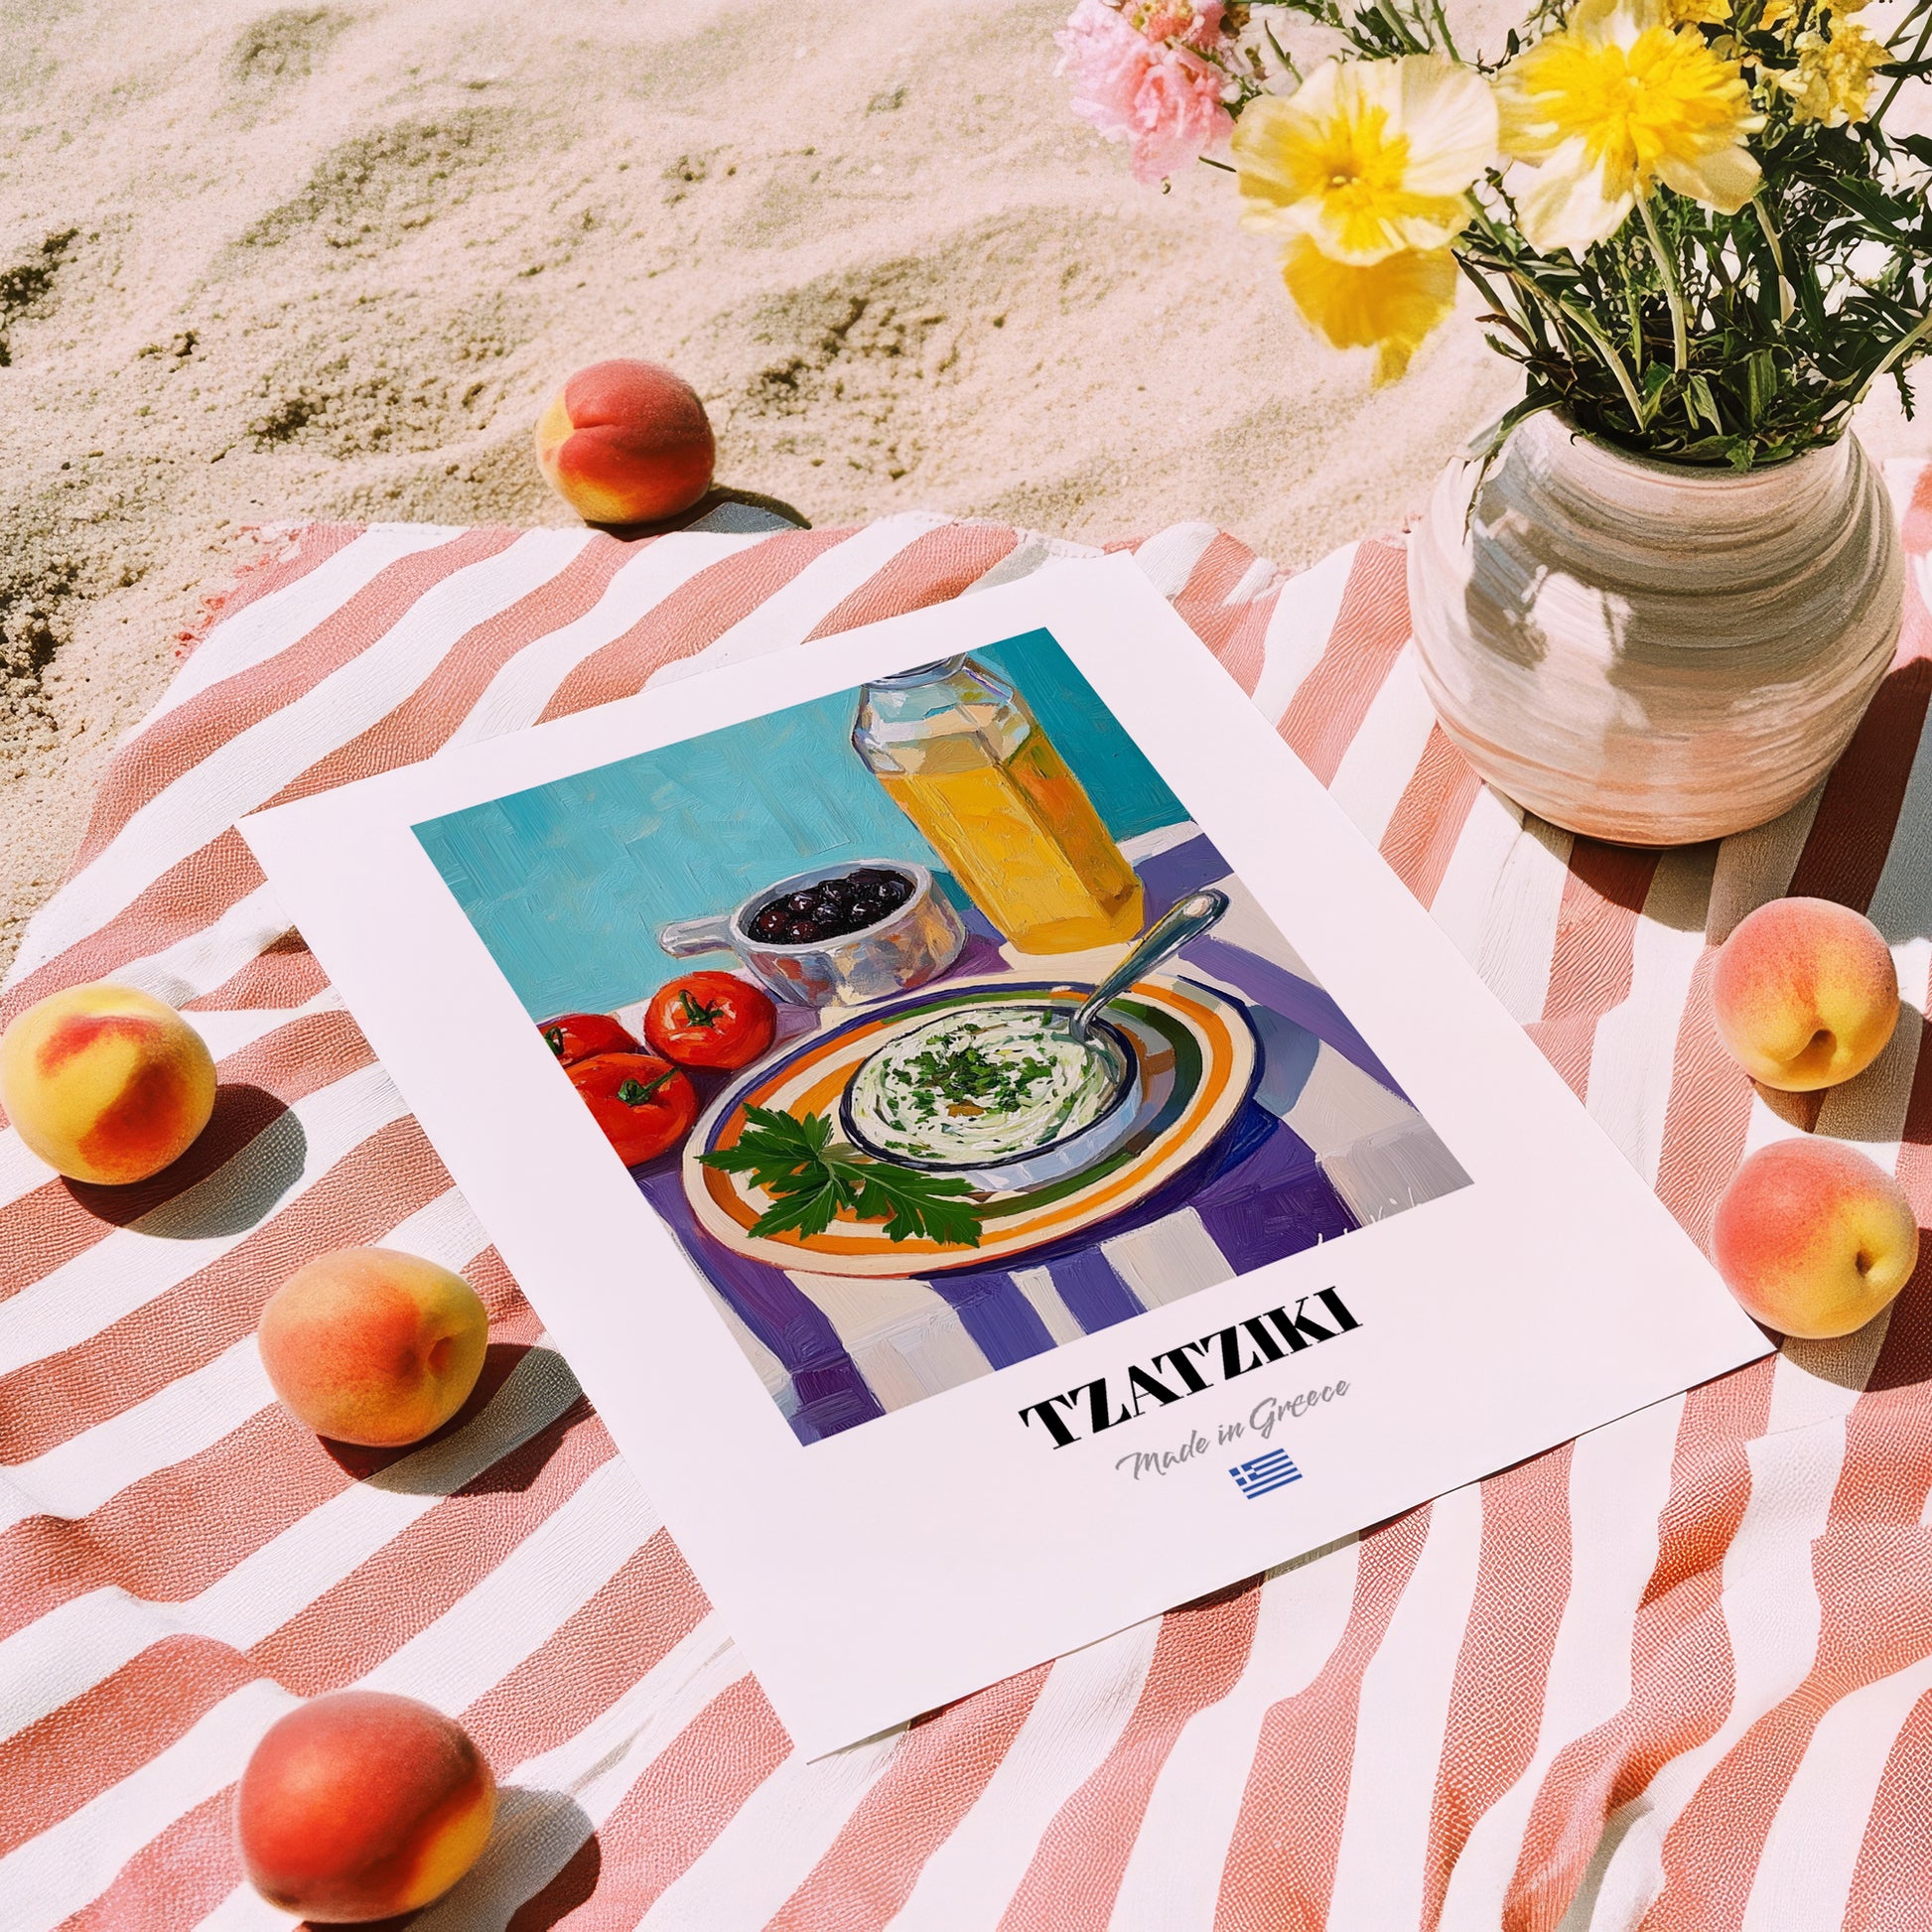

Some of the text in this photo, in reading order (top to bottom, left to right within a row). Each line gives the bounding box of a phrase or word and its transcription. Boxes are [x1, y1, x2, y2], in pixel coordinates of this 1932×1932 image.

[1018, 1286, 1363, 1449] TZATZIKI
[1115, 1379, 1351, 1480] Made in Greece
